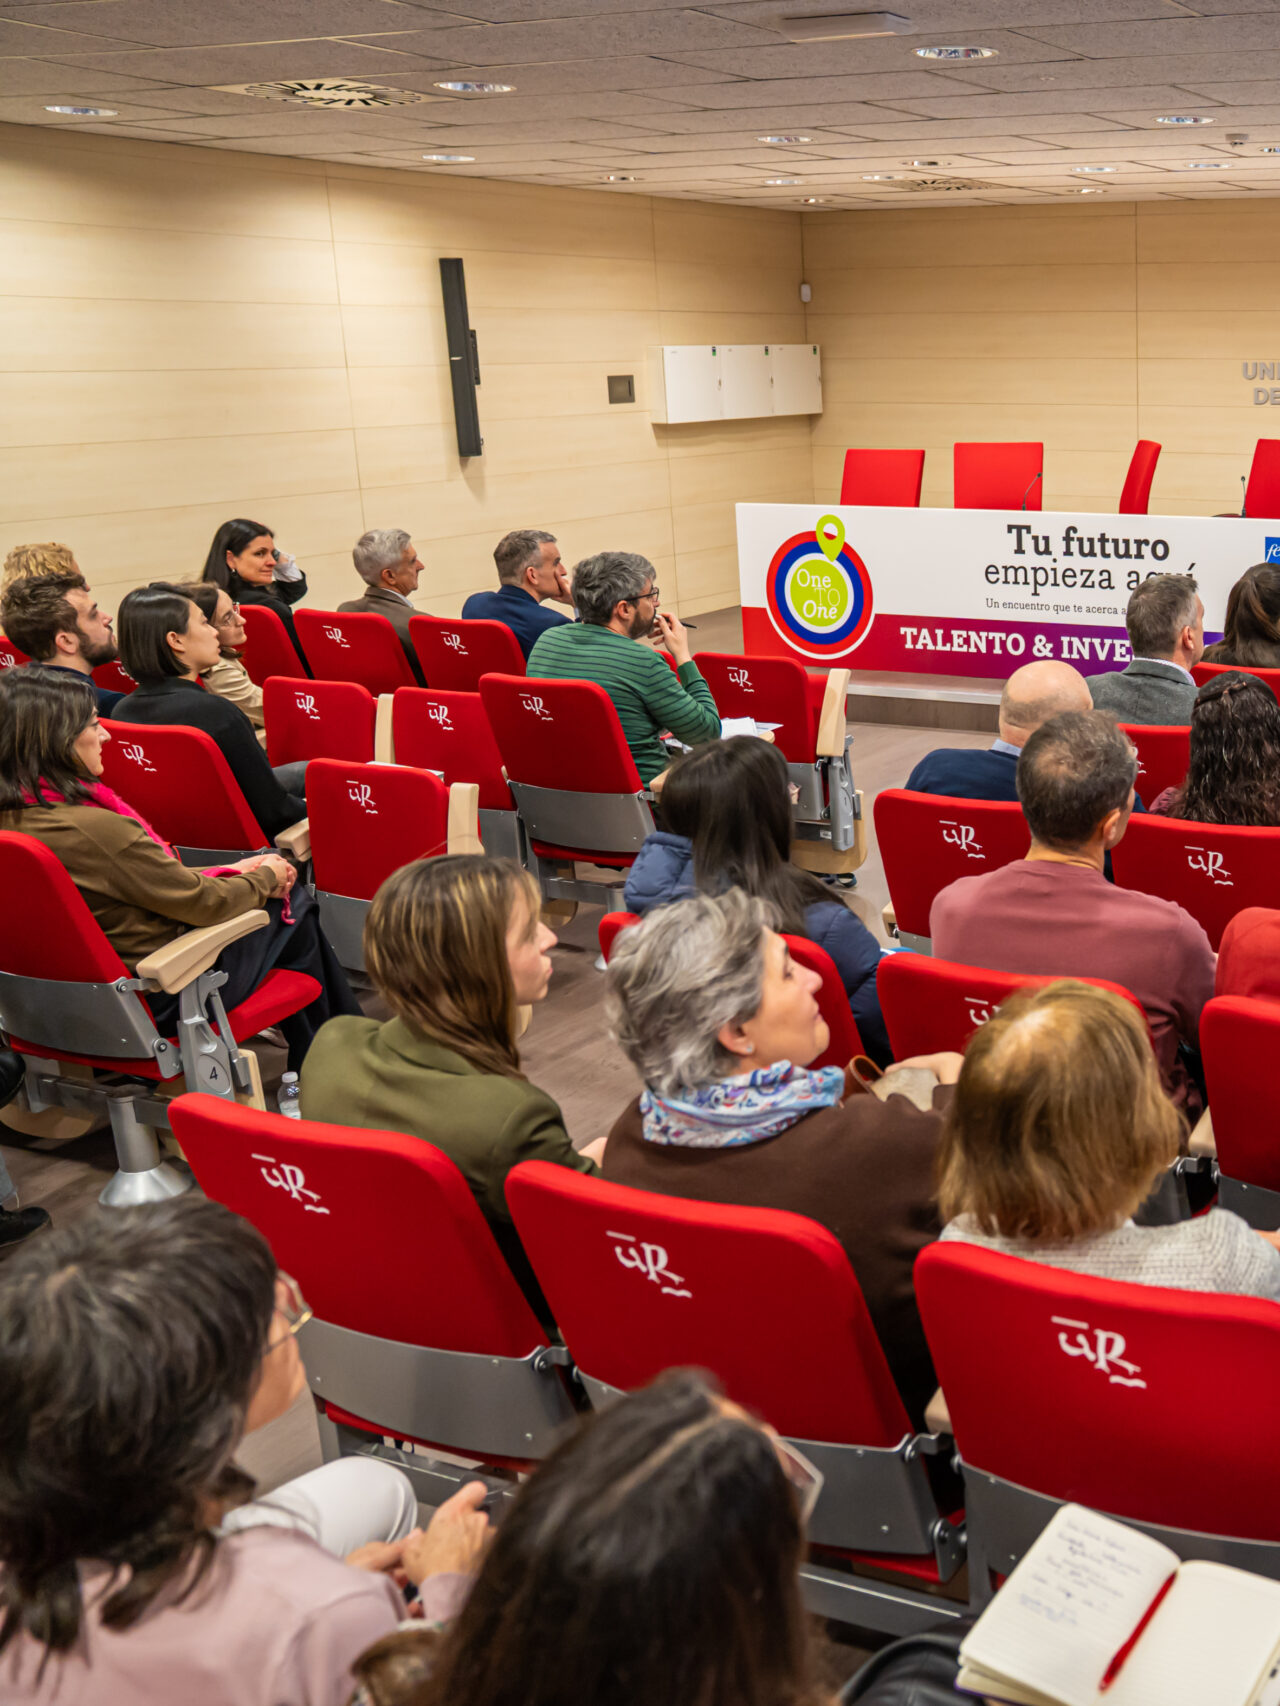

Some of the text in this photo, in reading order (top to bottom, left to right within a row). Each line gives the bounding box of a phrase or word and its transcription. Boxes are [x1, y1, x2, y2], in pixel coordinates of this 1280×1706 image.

[1007, 524, 1170, 561] Tu futuro
[797, 568, 832, 588] One
[984, 558, 1115, 596] empieza
[814, 587, 841, 607] TO
[985, 598, 1000, 609] Un
[1002, 600, 1051, 612] encuentro
[1053, 604, 1071, 614] que
[1073, 603, 1083, 613] te
[1085, 605, 1119, 615] acerca
[803, 600, 838, 619] One
[900, 626, 1026, 656] TALENTO
[1032, 634, 1053, 658] &
[209, 1066, 219, 1081] 4
